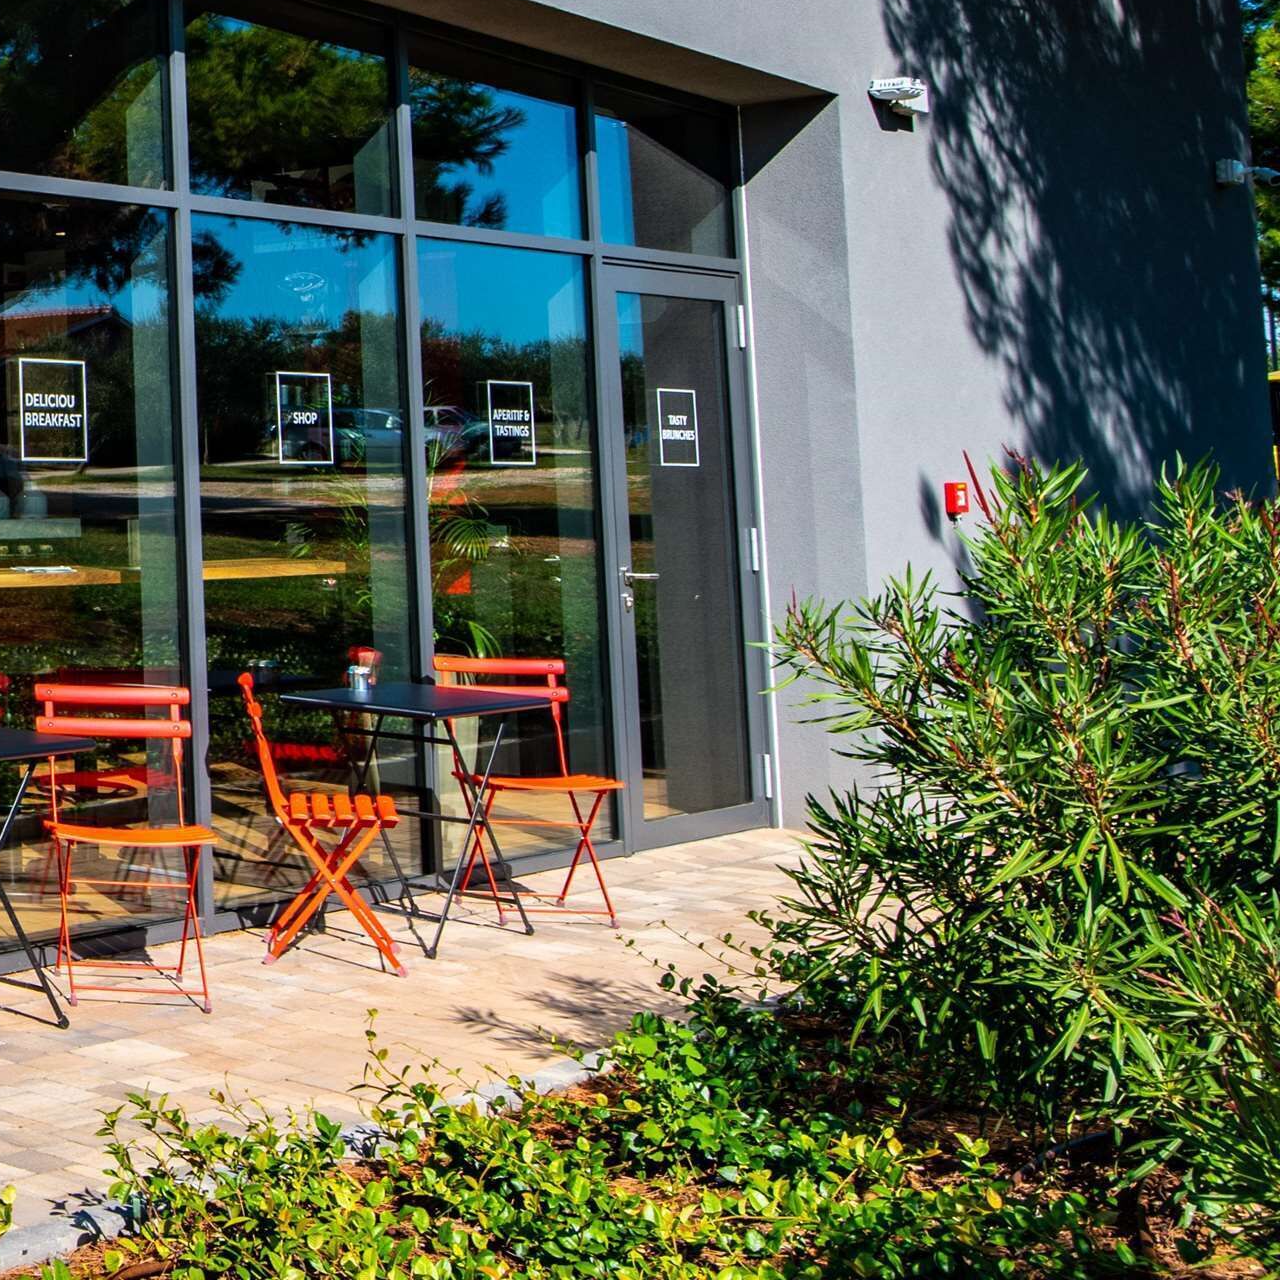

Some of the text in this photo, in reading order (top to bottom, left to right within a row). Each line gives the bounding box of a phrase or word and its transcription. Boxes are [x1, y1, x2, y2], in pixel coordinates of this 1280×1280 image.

[24, 392, 75, 408] DELICIOU
[24, 412, 82, 428] BREAKFAST
[293, 411, 318, 425] SHOP
[492, 408, 530, 422] APERITIF &
[667, 414, 688, 426] TASTY
[494, 424, 530, 438] TASTINGS
[662, 429, 695, 441] BRUNCHES
